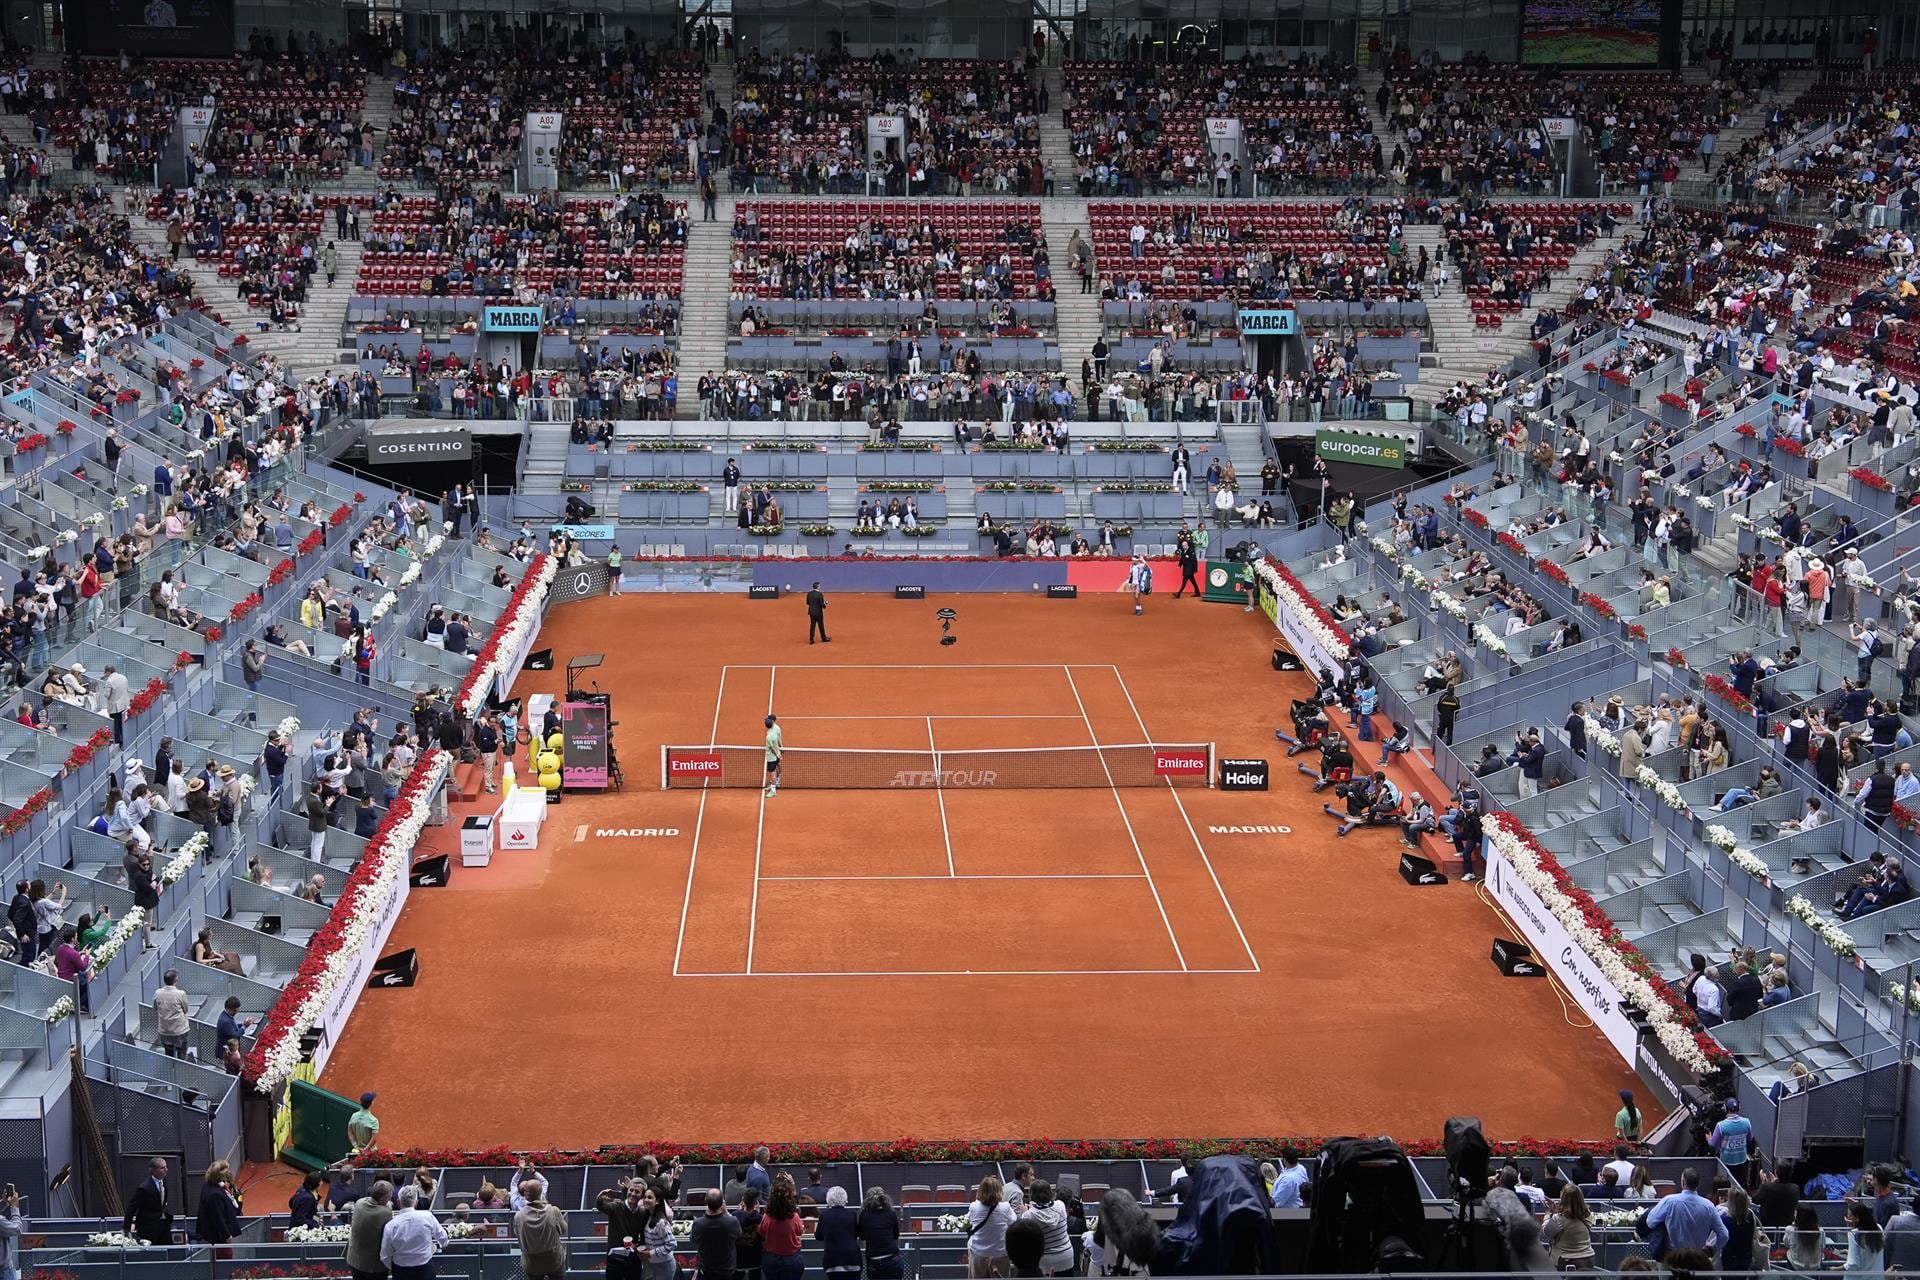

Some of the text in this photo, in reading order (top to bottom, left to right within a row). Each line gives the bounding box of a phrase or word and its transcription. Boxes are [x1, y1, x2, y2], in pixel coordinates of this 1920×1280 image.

[192, 111, 207, 120] A01
[539, 116, 554, 125] A02
[878, 119, 892, 128] A03
[1213, 121, 1228, 129] A04
[1548, 122, 1562, 130] A05
[490, 312, 539, 327] MARCA
[1241, 315, 1288, 330] MARCA
[378, 441, 463, 454] COSENTINO
[1321, 440, 1399, 459] europcar.es
[574, 530, 606, 538] SCORES
[672, 760, 720, 771] Emirates
[1157, 757, 1204, 769] Emirates
[1226, 772, 1264, 785] Haier
[595, 828, 680, 837] MADRID
[1208, 825, 1292, 833] MADRID
[1561, 946, 1610, 1015] Con nosotros
[1657, 1066, 1679, 1098] MADRID
